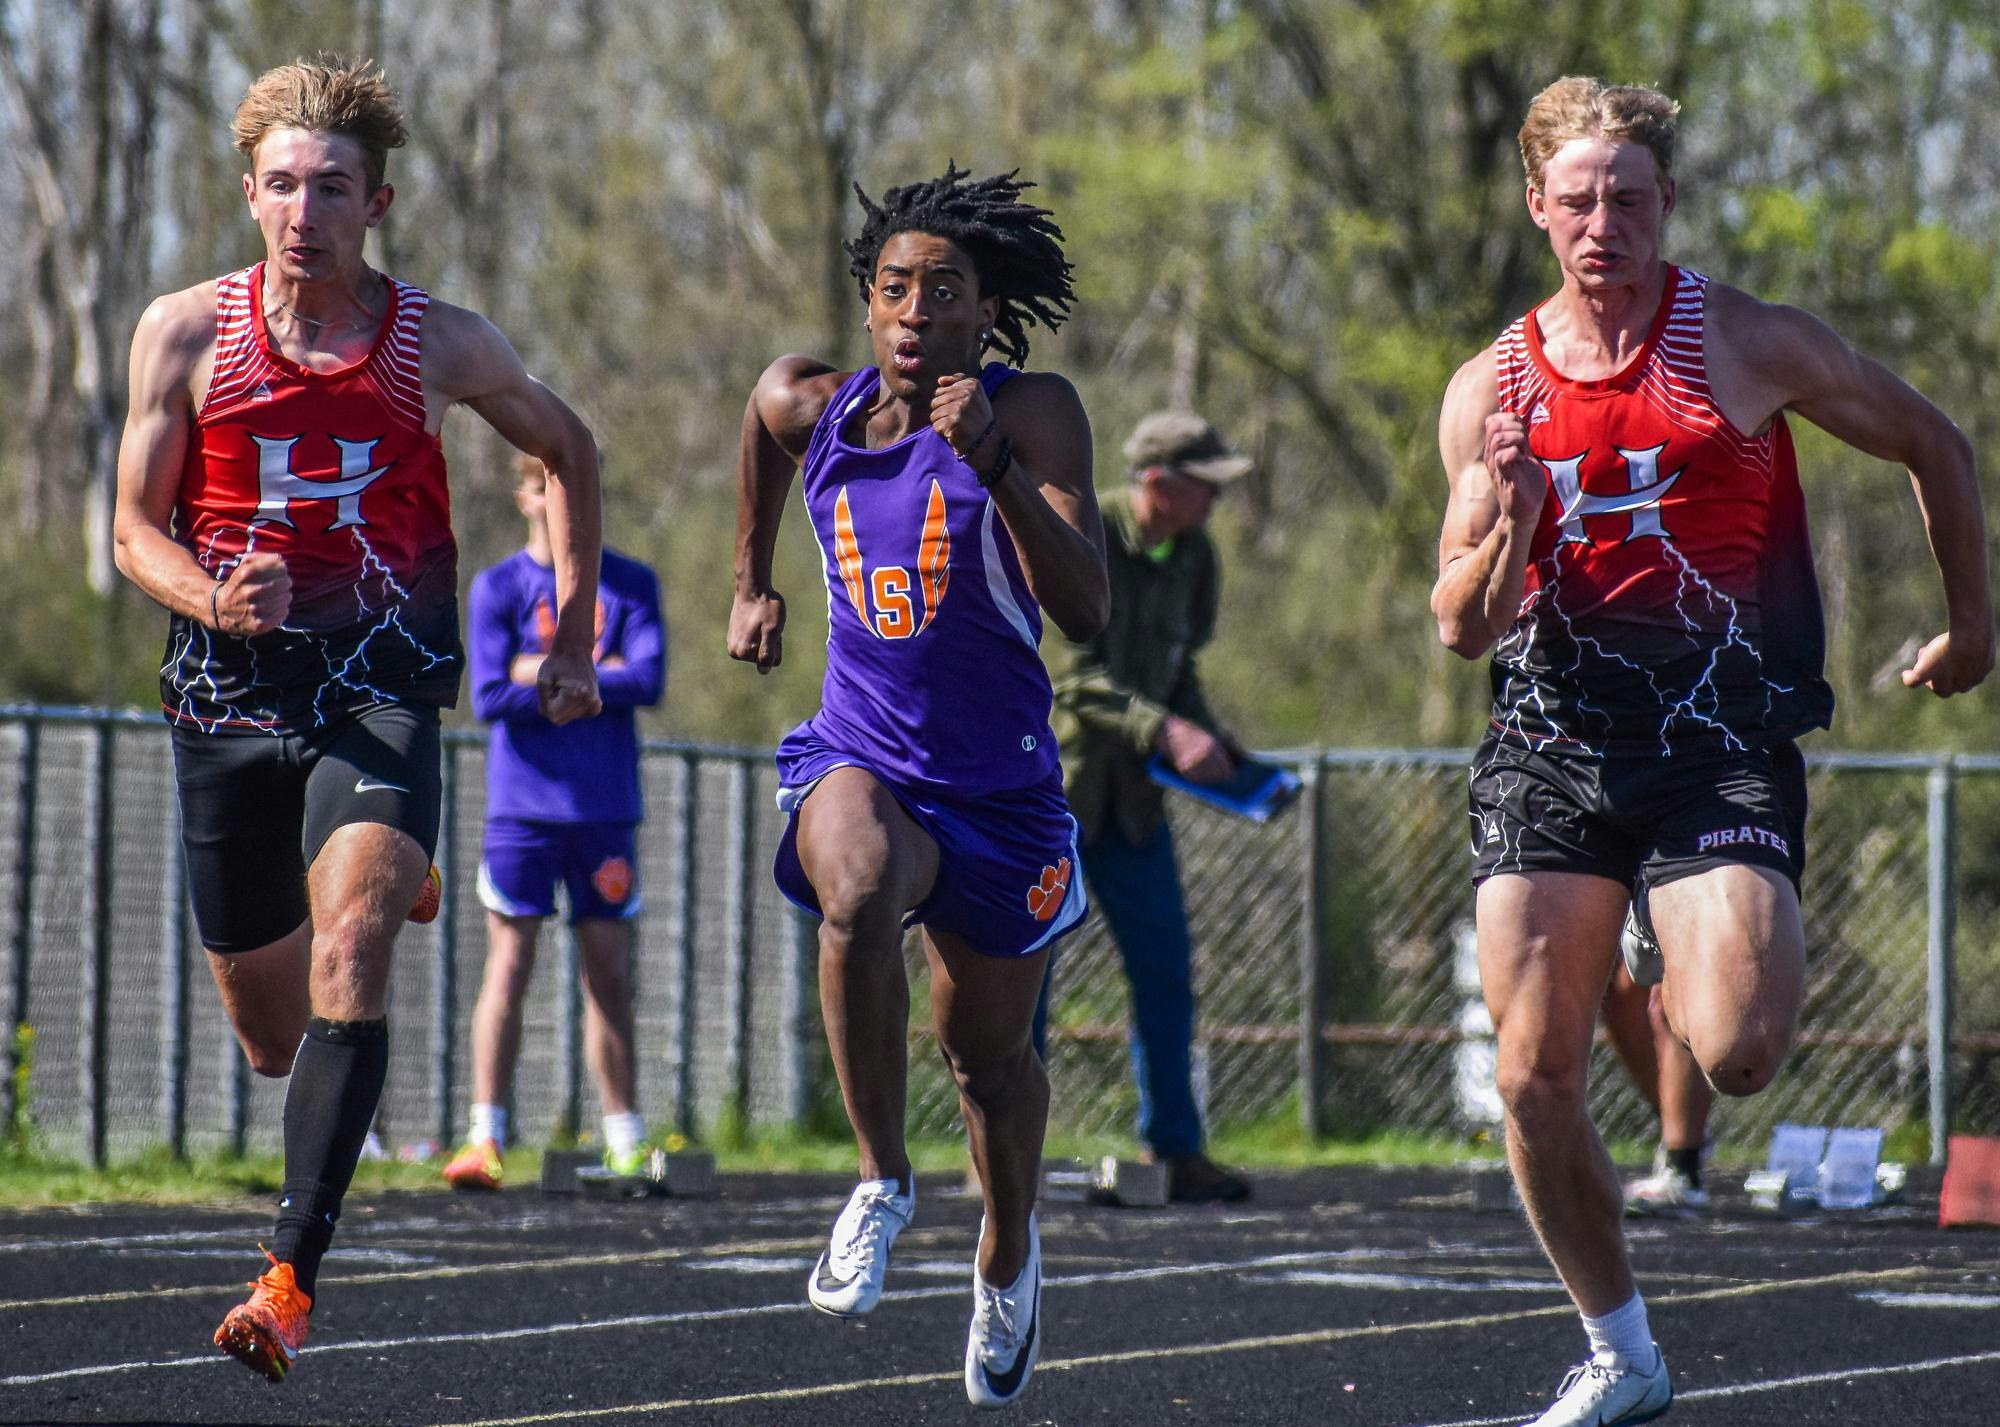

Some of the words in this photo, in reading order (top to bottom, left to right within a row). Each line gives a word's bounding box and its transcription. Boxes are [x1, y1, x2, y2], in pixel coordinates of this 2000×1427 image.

[247, 432, 397, 533] H
[1535, 440, 1687, 547] H
[871, 566, 915, 639] S
[1698, 826, 1789, 858] PIRATES
